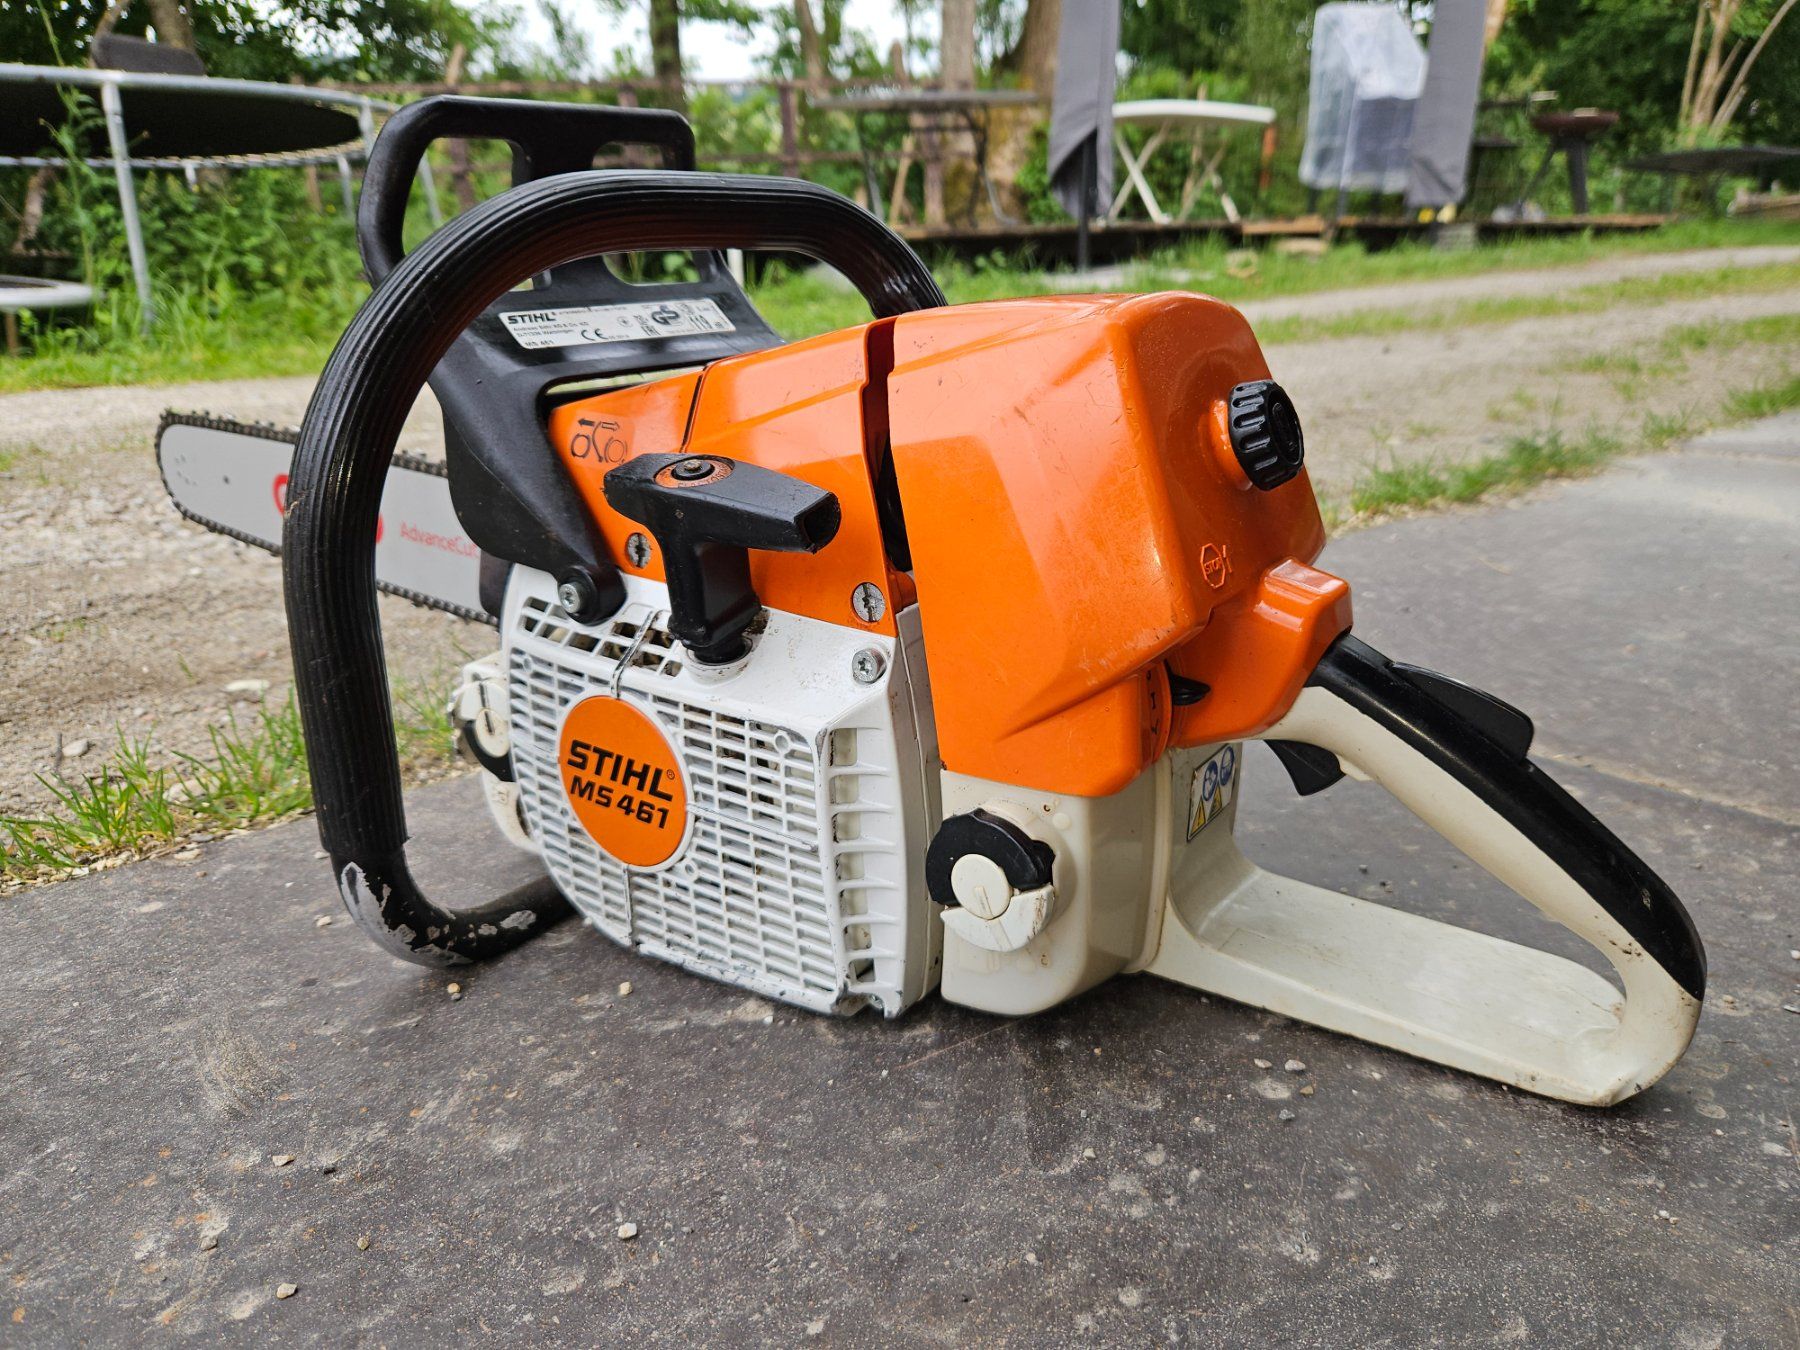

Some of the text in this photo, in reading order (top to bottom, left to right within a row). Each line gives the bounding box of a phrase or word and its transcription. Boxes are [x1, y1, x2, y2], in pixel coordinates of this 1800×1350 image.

[507, 312, 556, 325] STIHL
[567, 739, 674, 802] STIHL
[570, 774, 670, 830] MS 461
